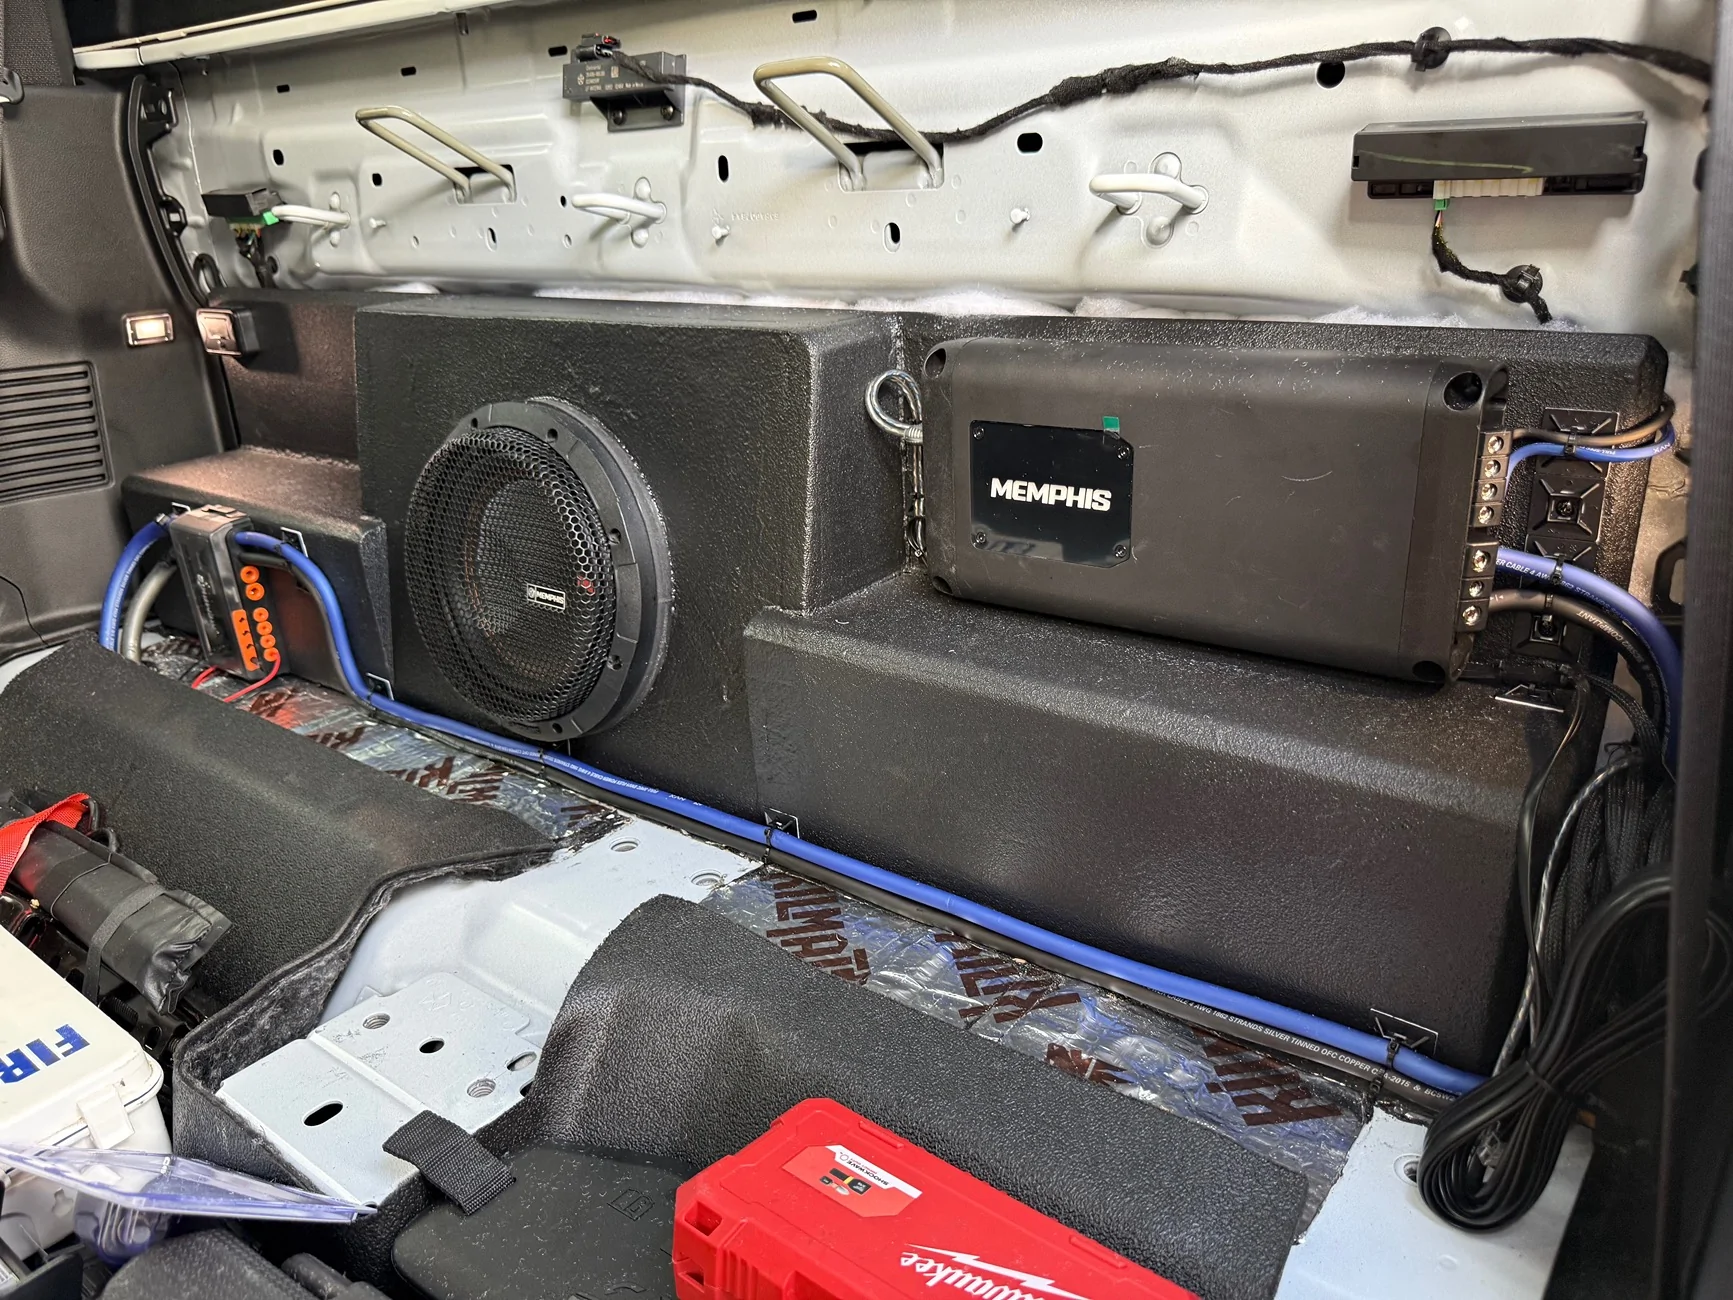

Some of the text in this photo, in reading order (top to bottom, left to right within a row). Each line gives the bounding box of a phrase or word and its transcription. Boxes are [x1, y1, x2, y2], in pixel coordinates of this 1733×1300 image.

[1653, 443, 1671, 454] NVX
[990, 478, 1112, 512] MEMPHIS
[1506, 561, 1530, 574] CABLE
[1536, 572, 1550, 581] AW
[536, 590, 564, 604] MEMPHIS
[1576, 610, 1622, 642] COMPLIANT
[0, 1024, 90, 1083] FIR
[1194, 1004, 1211, 1014] AWG
[1212, 1009, 1228, 1020] 1862
[1228, 1016, 1263, 1032] STRANDS
[1263, 1027, 1290, 1042] SILVER
[1290, 1037, 1320, 1052] TINNED
[1320, 1048, 1338, 1059] OFC
[1338, 1054, 1371, 1071] COPPER
[1371, 1068, 1410, 1088] CA-2015
[847, 1160, 889, 1186] SHOCKWAVE
